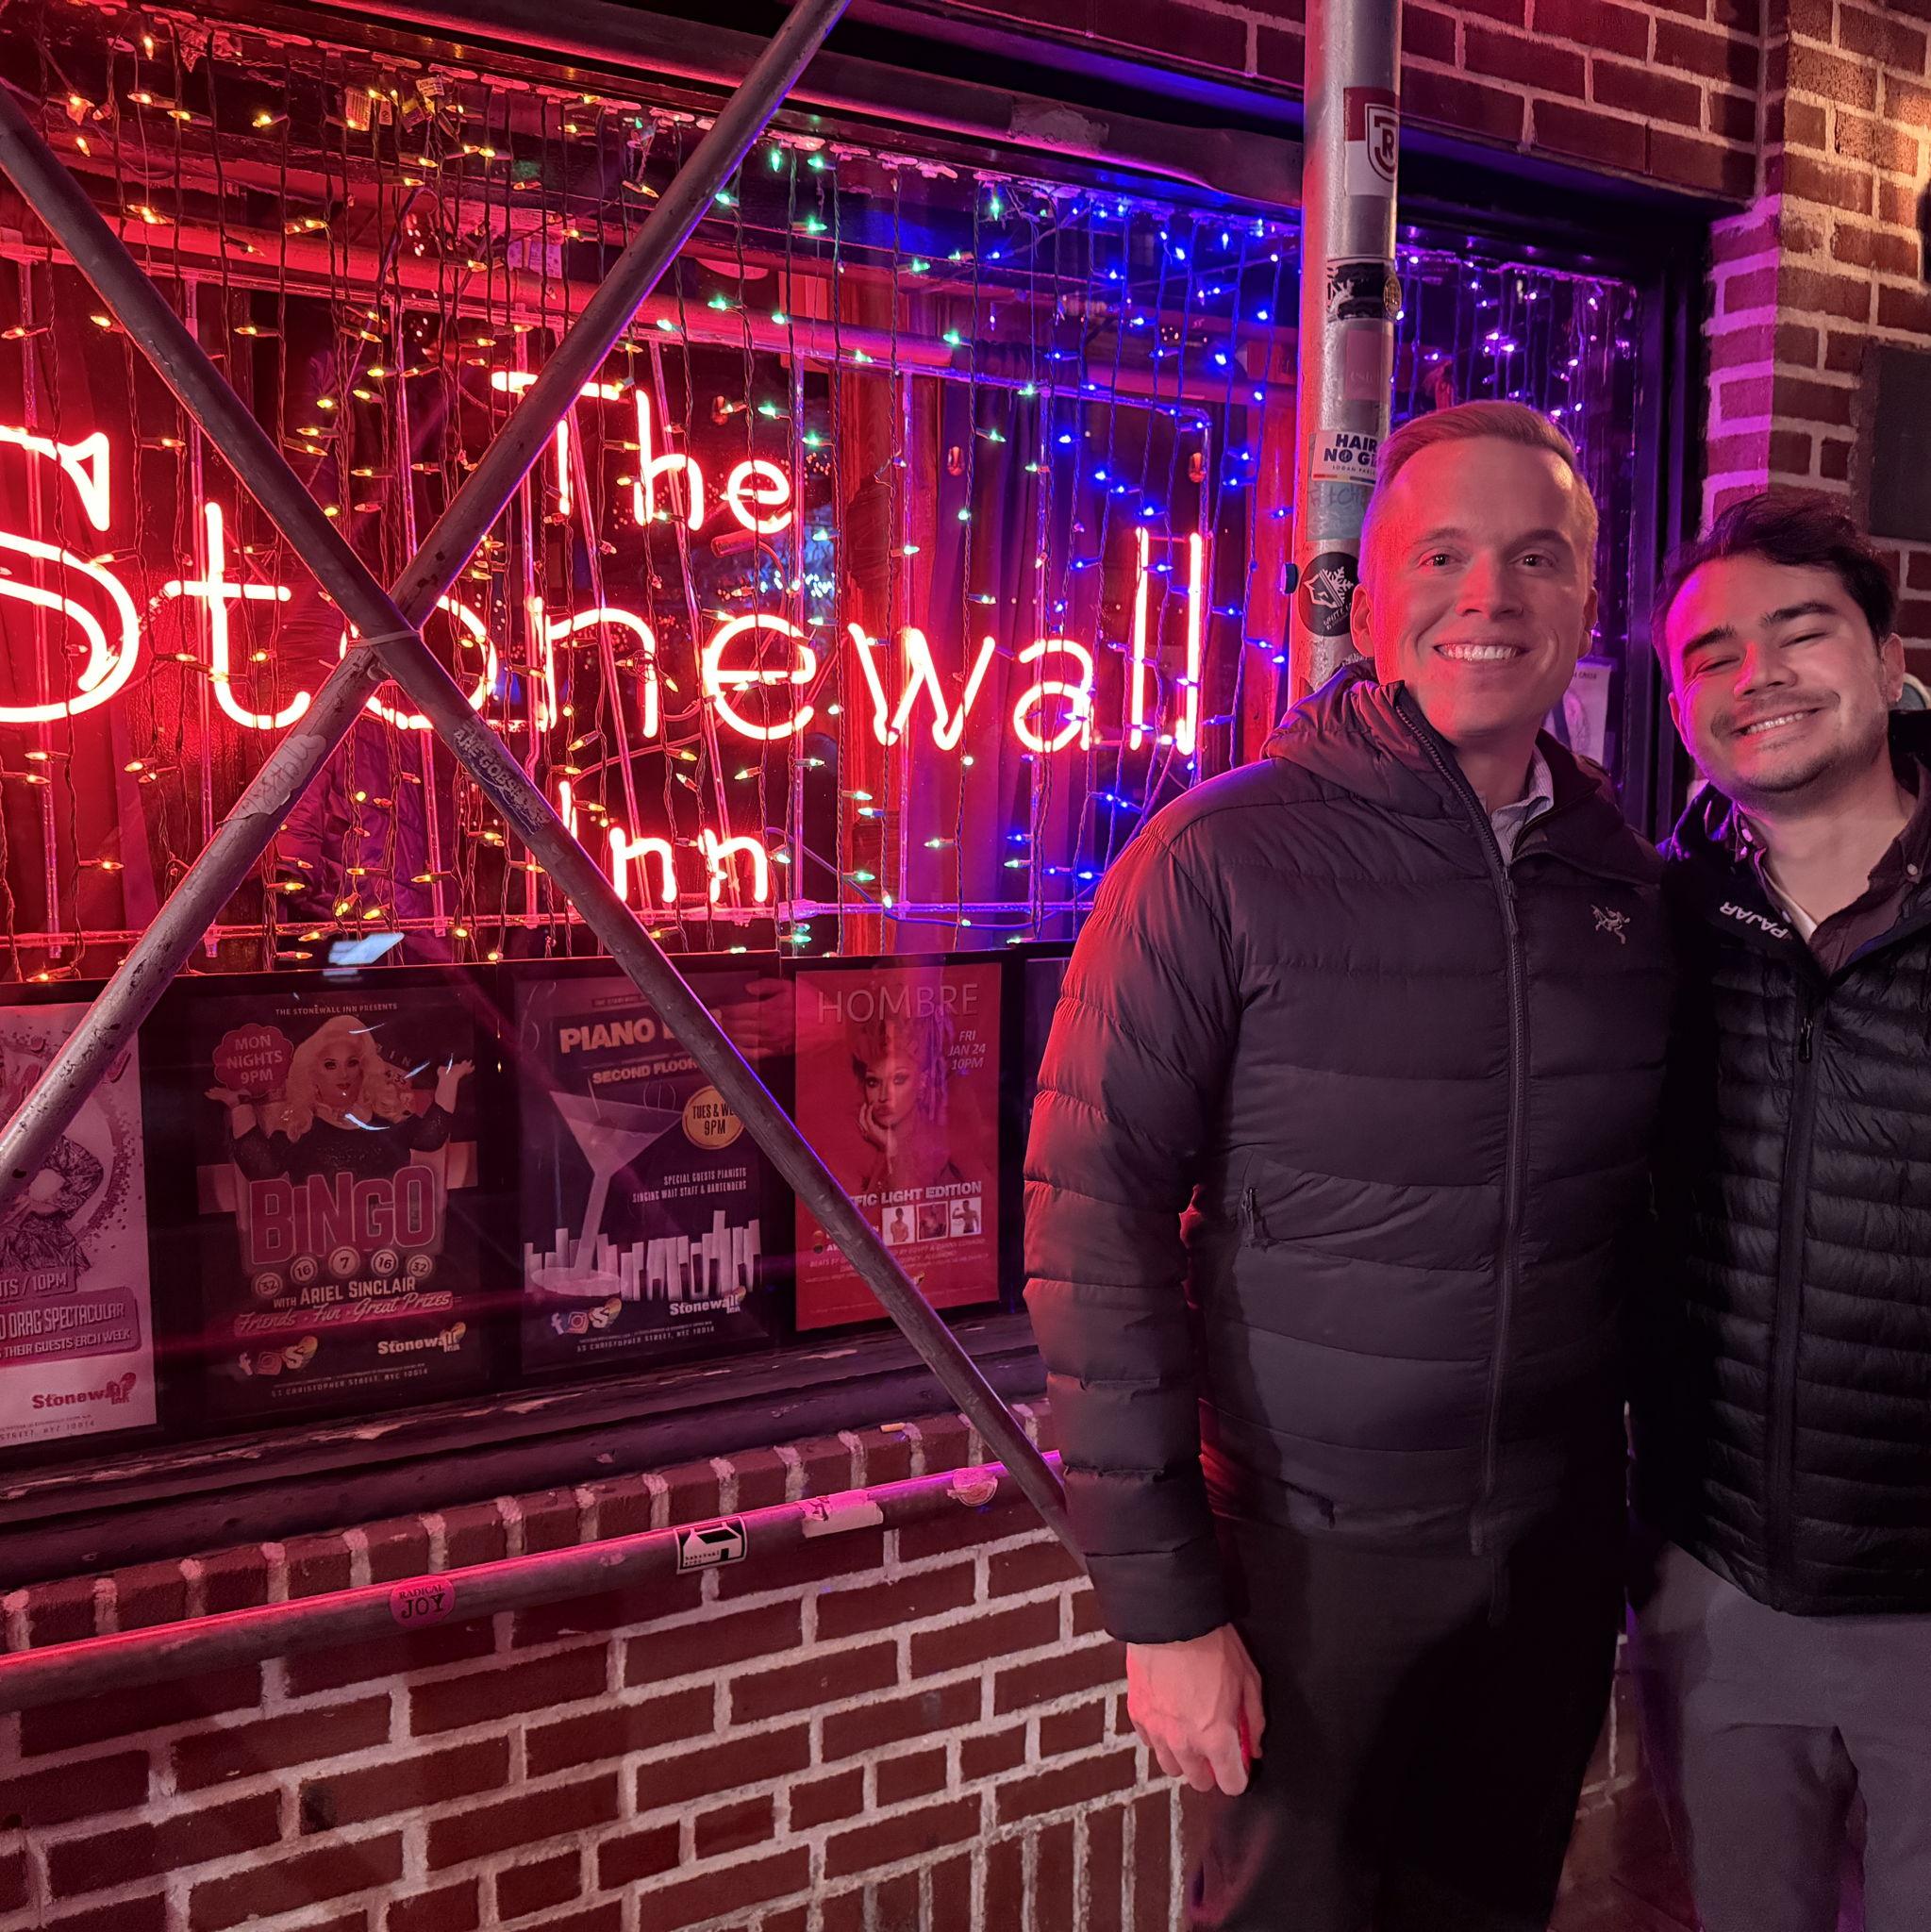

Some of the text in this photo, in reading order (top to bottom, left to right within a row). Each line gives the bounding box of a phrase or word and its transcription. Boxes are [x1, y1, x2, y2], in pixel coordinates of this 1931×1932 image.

[491, 370, 794, 534] The
[1336, 434, 1377, 452] HAIR
[1323, 448, 1353, 463] NO
[1720, 902, 1789, 939] PAJAR
[275, 1003, 398, 1016] THE STONEWALL INN PRESENTS
[818, 982, 979, 1024] HOMBRE
[235, 1034, 272, 1052] MON
[559, 1018, 656, 1054] PIANO
[959, 1029, 976, 1042] FRI
[948, 1042, 987, 1058] JAN 24
[226, 1049, 283, 1071] NIGHTS
[951, 1057, 985, 1071] 10PM
[240, 1067, 274, 1085] 9PM
[592, 1065, 651, 1085] SECOND
[692, 1104, 712, 1120] TUES
[713, 1103, 719, 1117] &
[704, 1119, 726, 1136] 9PM
[663, 1167, 747, 1187] SPECIAL GUESTS PIANISTS
[632, 1190, 659, 1204] SINGING
[661, 1188, 677, 1200] WAIT
[679, 1185, 698, 1198] STAFF
[707, 1180, 747, 1193] BARTENDERS
[881, 1188, 923, 1205] LIGHT
[925, 1181, 982, 1199] EDITION
[249, 1165, 436, 1265] BINGO
[296, 1265, 311, 1277] 16
[339, 1257, 350, 1270] 7
[377, 1256, 392, 1270] 16
[411, 1260, 427, 1274] 32
[32, 1273, 67, 1292] 10PM
[258, 1278, 278, 1291] 32
[274, 1276, 416, 1308] WITH ARIEL SINCLAIR
[312, 1302, 341, 1323] Fun
[354, 1296, 397, 1322] Great
[670, 1294, 740, 1316] Stonewall
[8, 1308, 43, 1338] DRAG
[44, 1303, 125, 1333] SPECTACULAR
[5, 1343, 33, 1358] THEIR
[35, 1338, 74, 1354] GUESTS
[104, 1328, 132, 1343] WEEK
[398, 1584, 444, 1599] RADICAL
[401, 1592, 446, 1619] JOY
